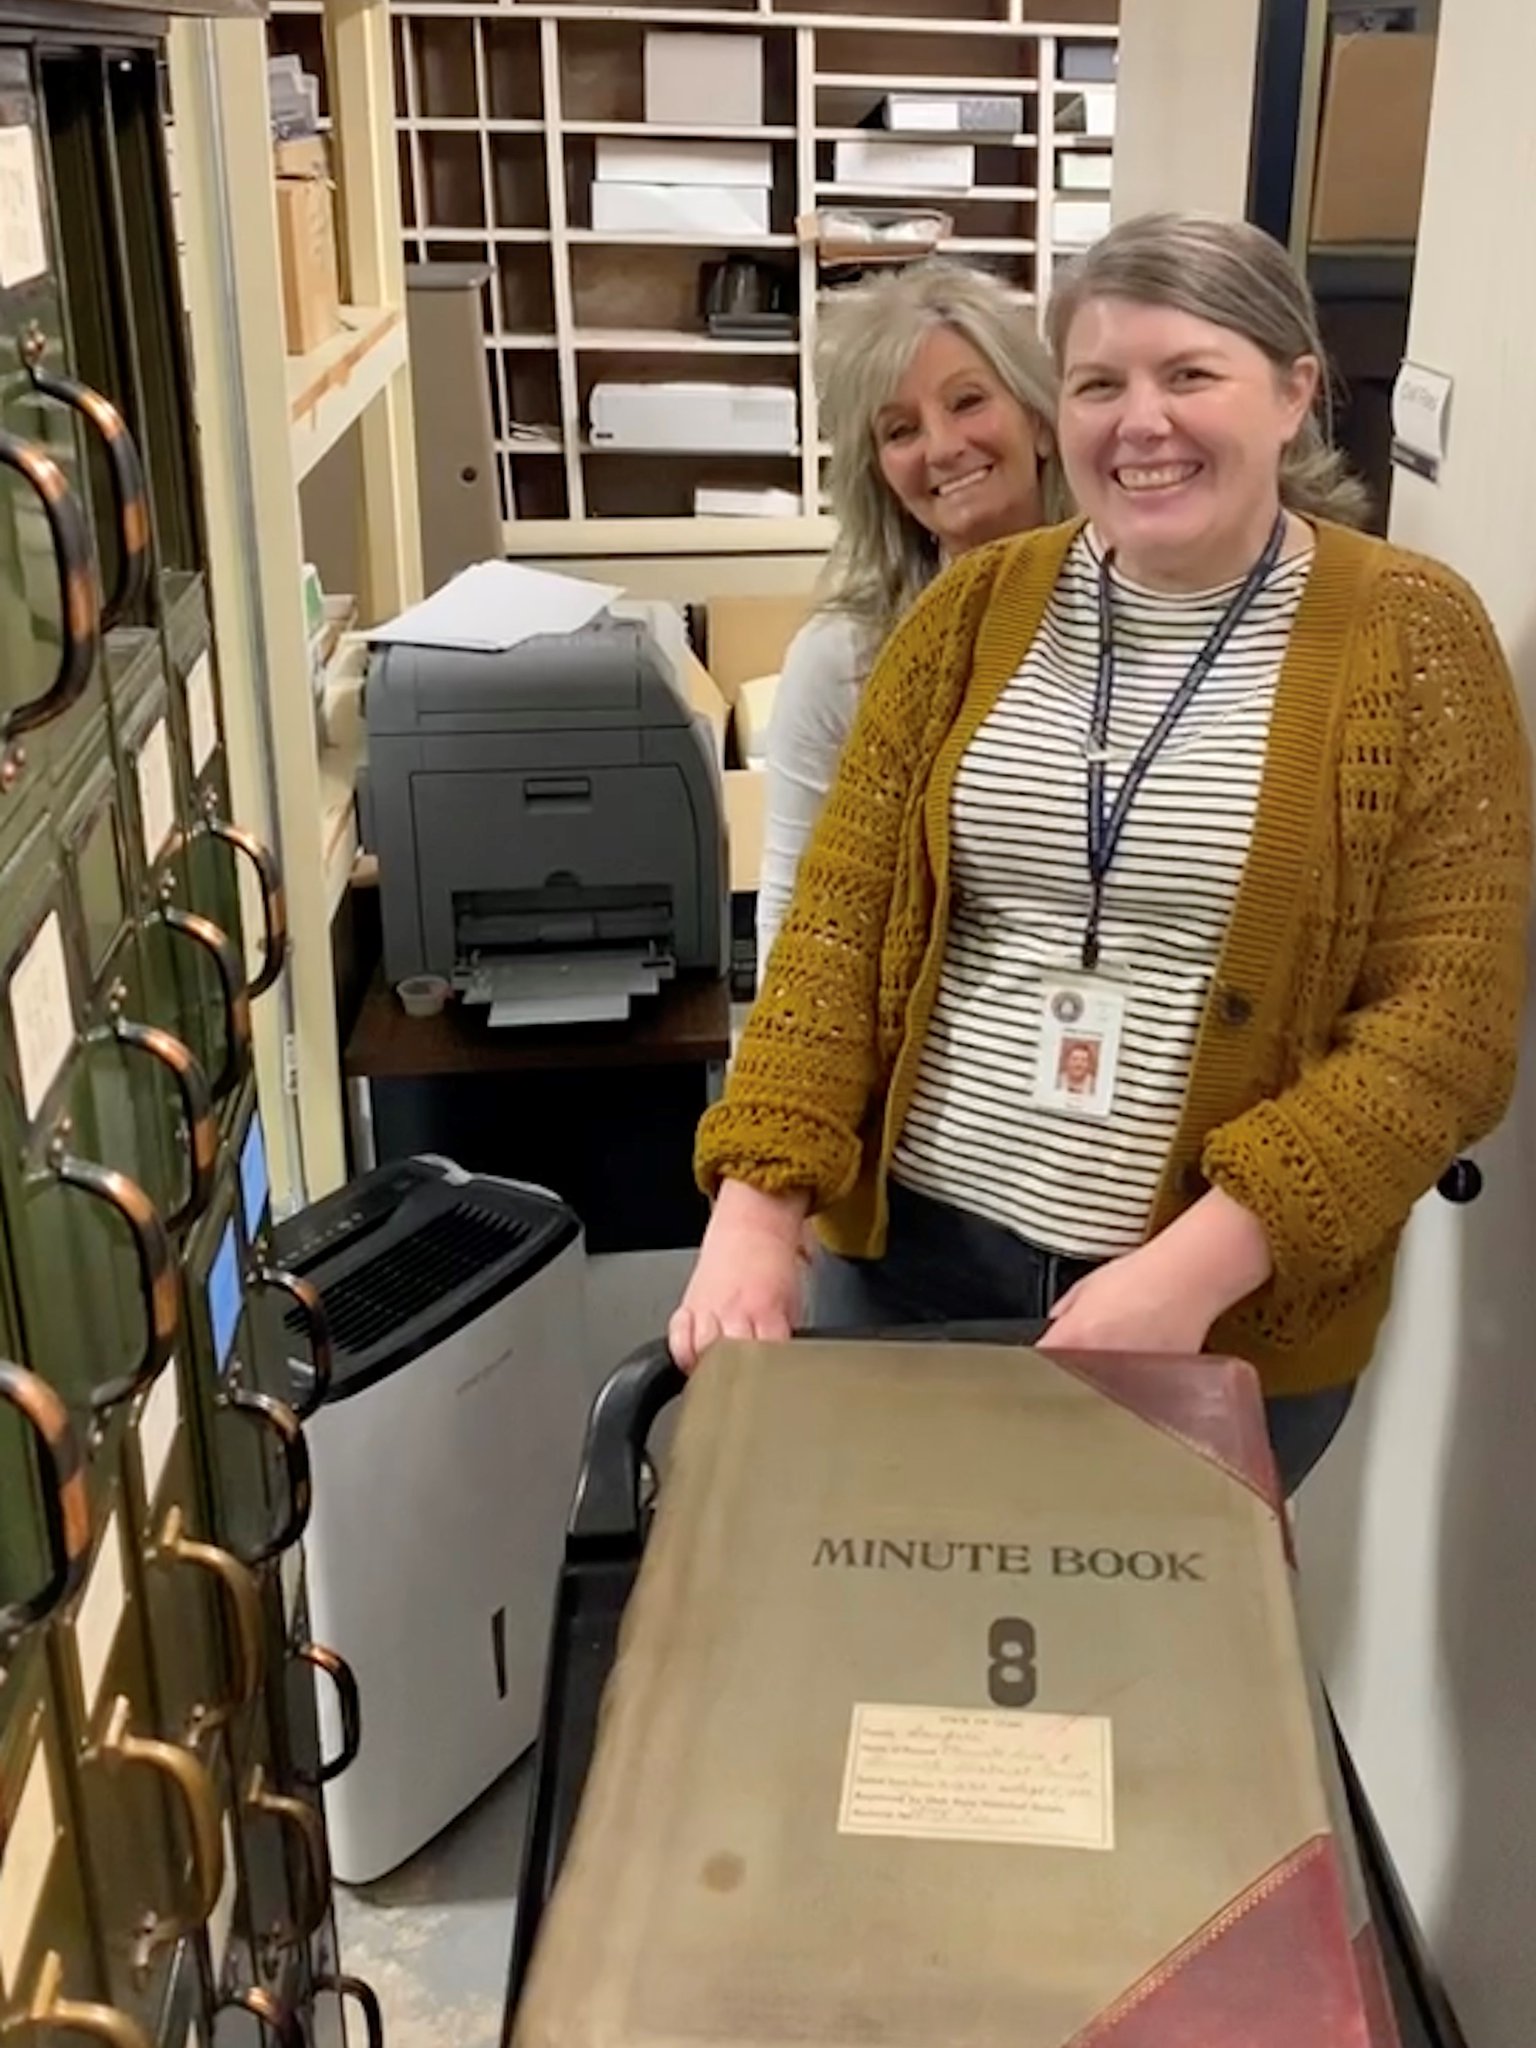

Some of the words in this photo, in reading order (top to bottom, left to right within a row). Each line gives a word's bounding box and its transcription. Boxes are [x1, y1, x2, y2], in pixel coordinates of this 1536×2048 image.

[812, 1538, 1030, 1574] MINUTE
[1052, 1547, 1205, 1581] BOOK
[988, 1617, 1036, 1708] 8
